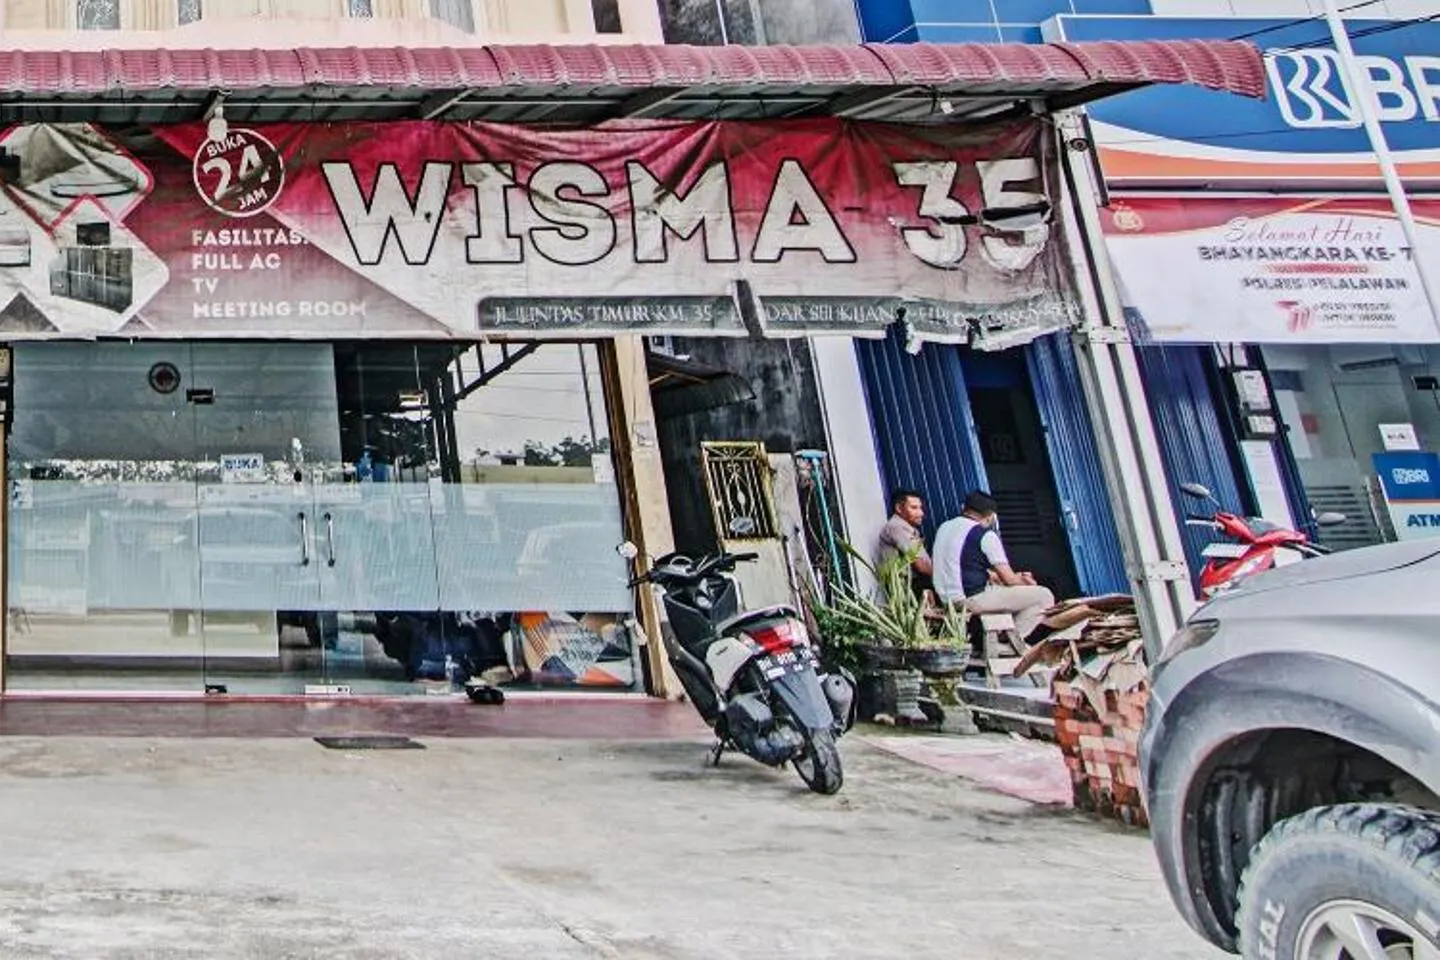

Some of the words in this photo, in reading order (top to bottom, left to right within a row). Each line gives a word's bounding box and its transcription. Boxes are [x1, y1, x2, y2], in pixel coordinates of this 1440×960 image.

[207, 134, 247, 157] BUKA
[202, 145, 271, 200] 24
[238, 188, 268, 210] JAM
[321, 158, 857, 265] WISMA
[893, 158, 1052, 270] 35
[192, 253, 242, 270] FULL
[249, 253, 281, 270] AC
[1198, 246, 1358, 261] BHAYANGKARA
[192, 278, 219, 294] TV
[193, 301, 293, 319] MEETING
[298, 301, 367, 318] ROOM
